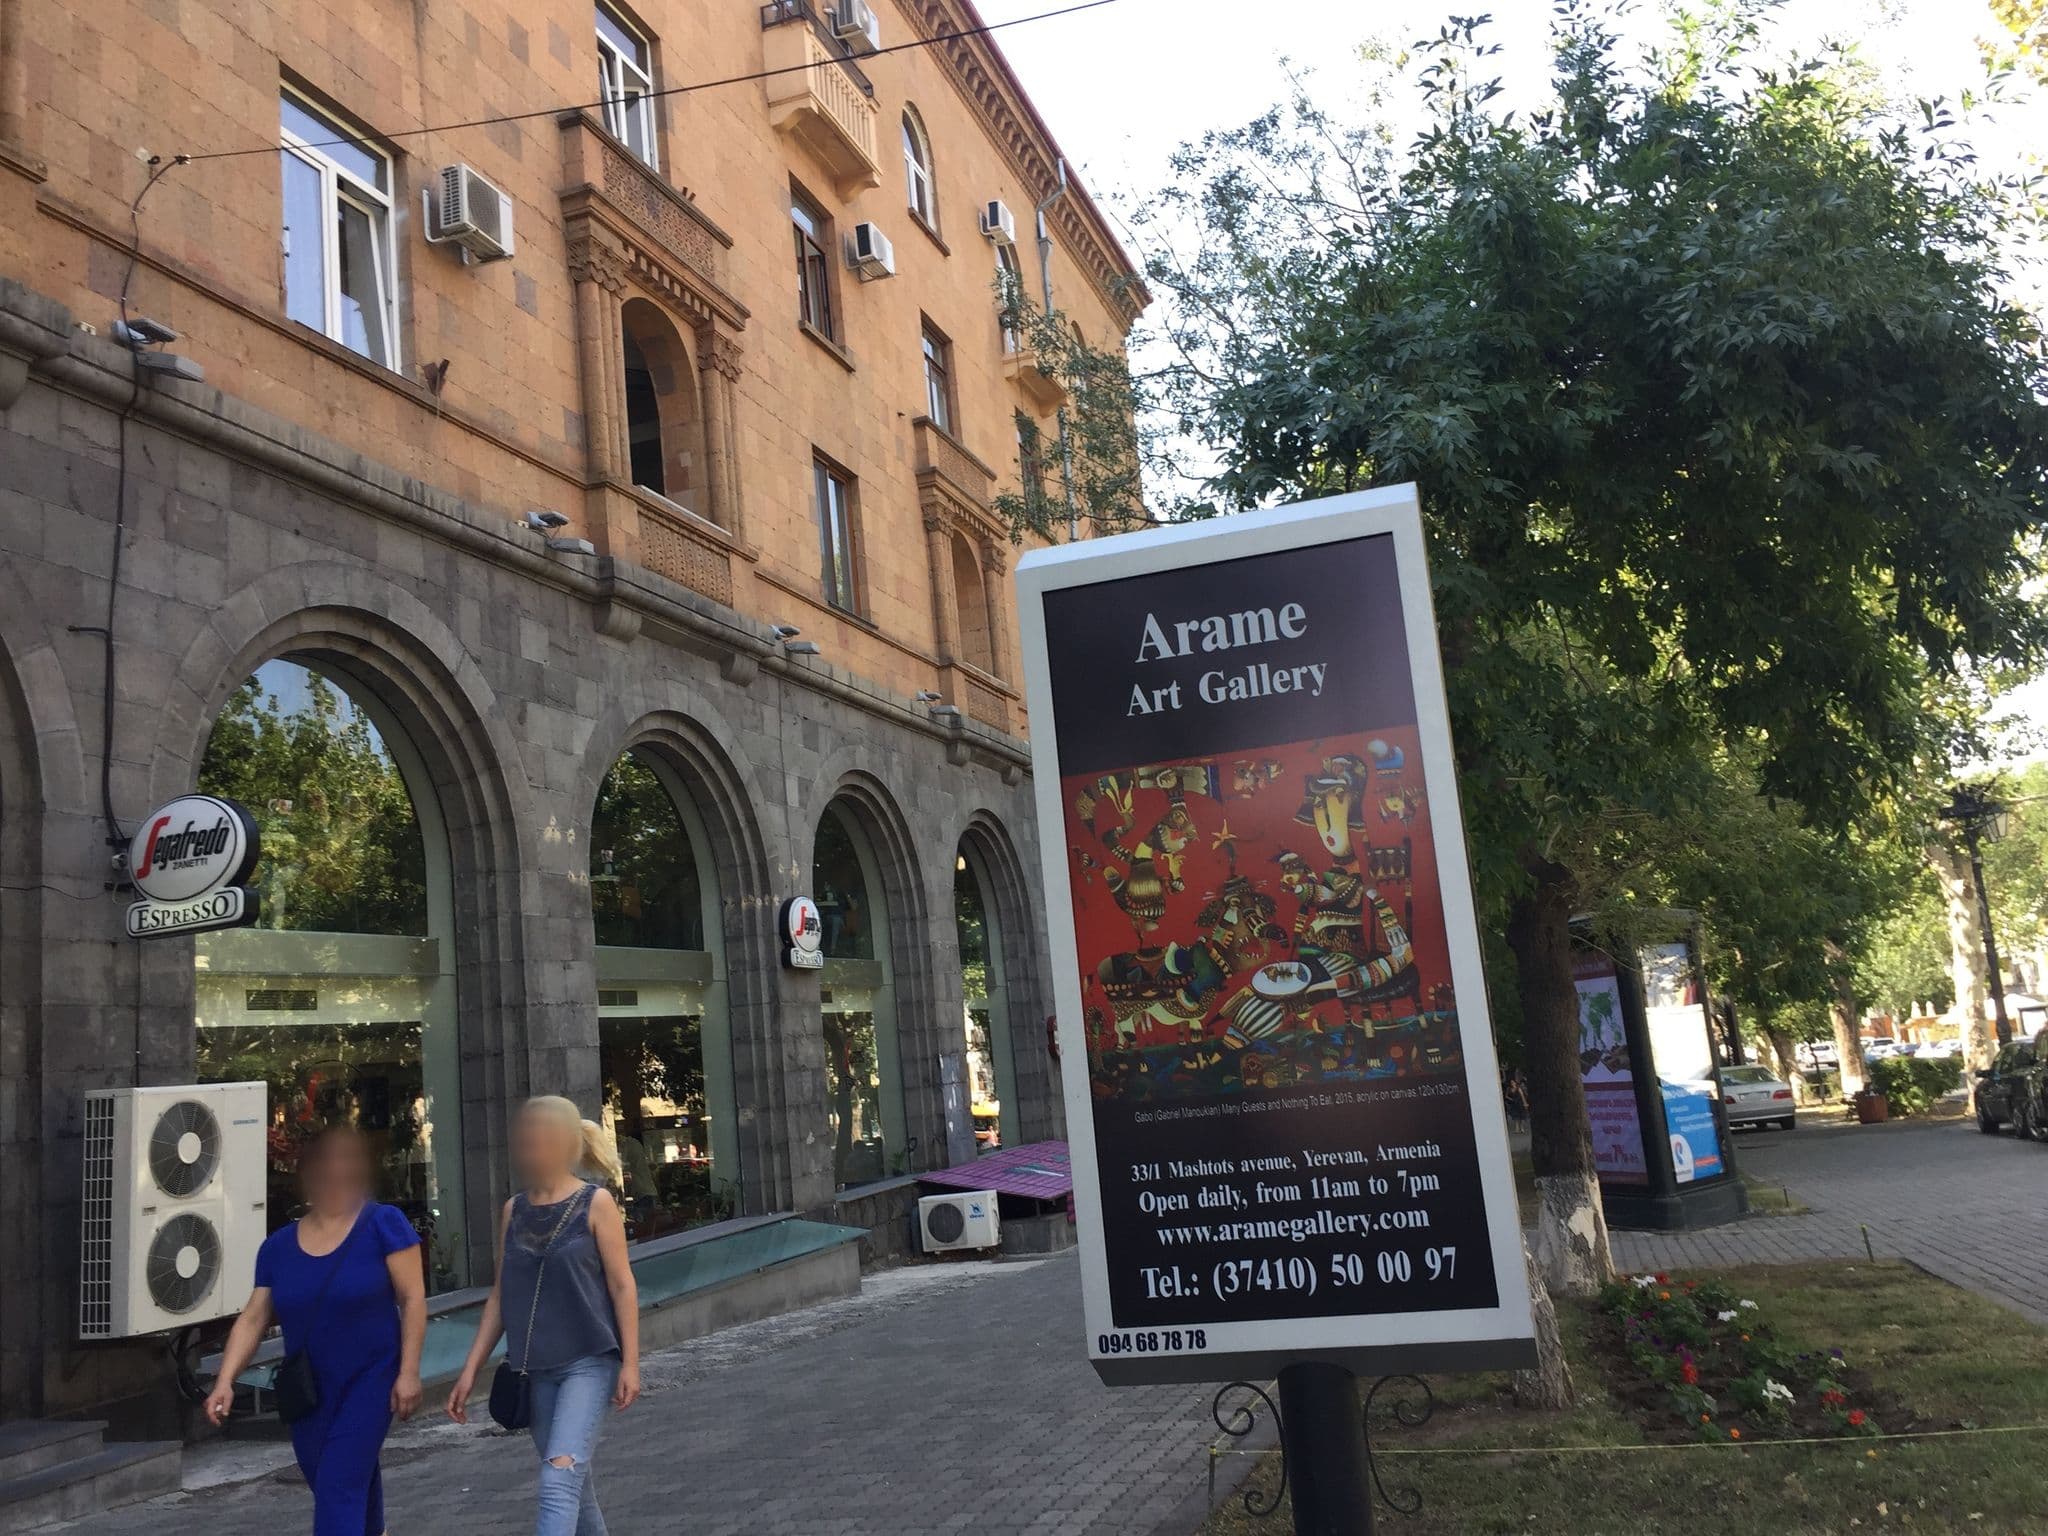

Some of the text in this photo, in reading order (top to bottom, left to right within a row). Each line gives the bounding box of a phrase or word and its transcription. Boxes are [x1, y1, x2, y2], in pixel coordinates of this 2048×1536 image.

[1134, 601, 1308, 664] Arame
[1126, 662, 1328, 717] Art Gallery
[136, 815, 230, 880] Segafredo
[172, 857, 209, 871] ZANETTI
[136, 895, 230, 931] ESPRESSO
[1241, 1100, 1266, 1113] Guests
[1267, 1099, 1281, 1110] and
[1281, 1096, 1309, 1110] Nothing
[1309, 1095, 1319, 1107] To
[1380, 1089, 1391, 1100] on
[1130, 1139, 1442, 1182] 33/1 Mashtots avenue, Yerevan, Armenia
[1138, 1169, 1441, 1217] Open daily, from 11am to 7pm
[1156, 1209, 1431, 1247] www.aramegallery.com
[1140, 1246, 1456, 1302] Tel.: (37410) 50 00 97
[1098, 1328, 1207, 1354] 094 68 78 78
